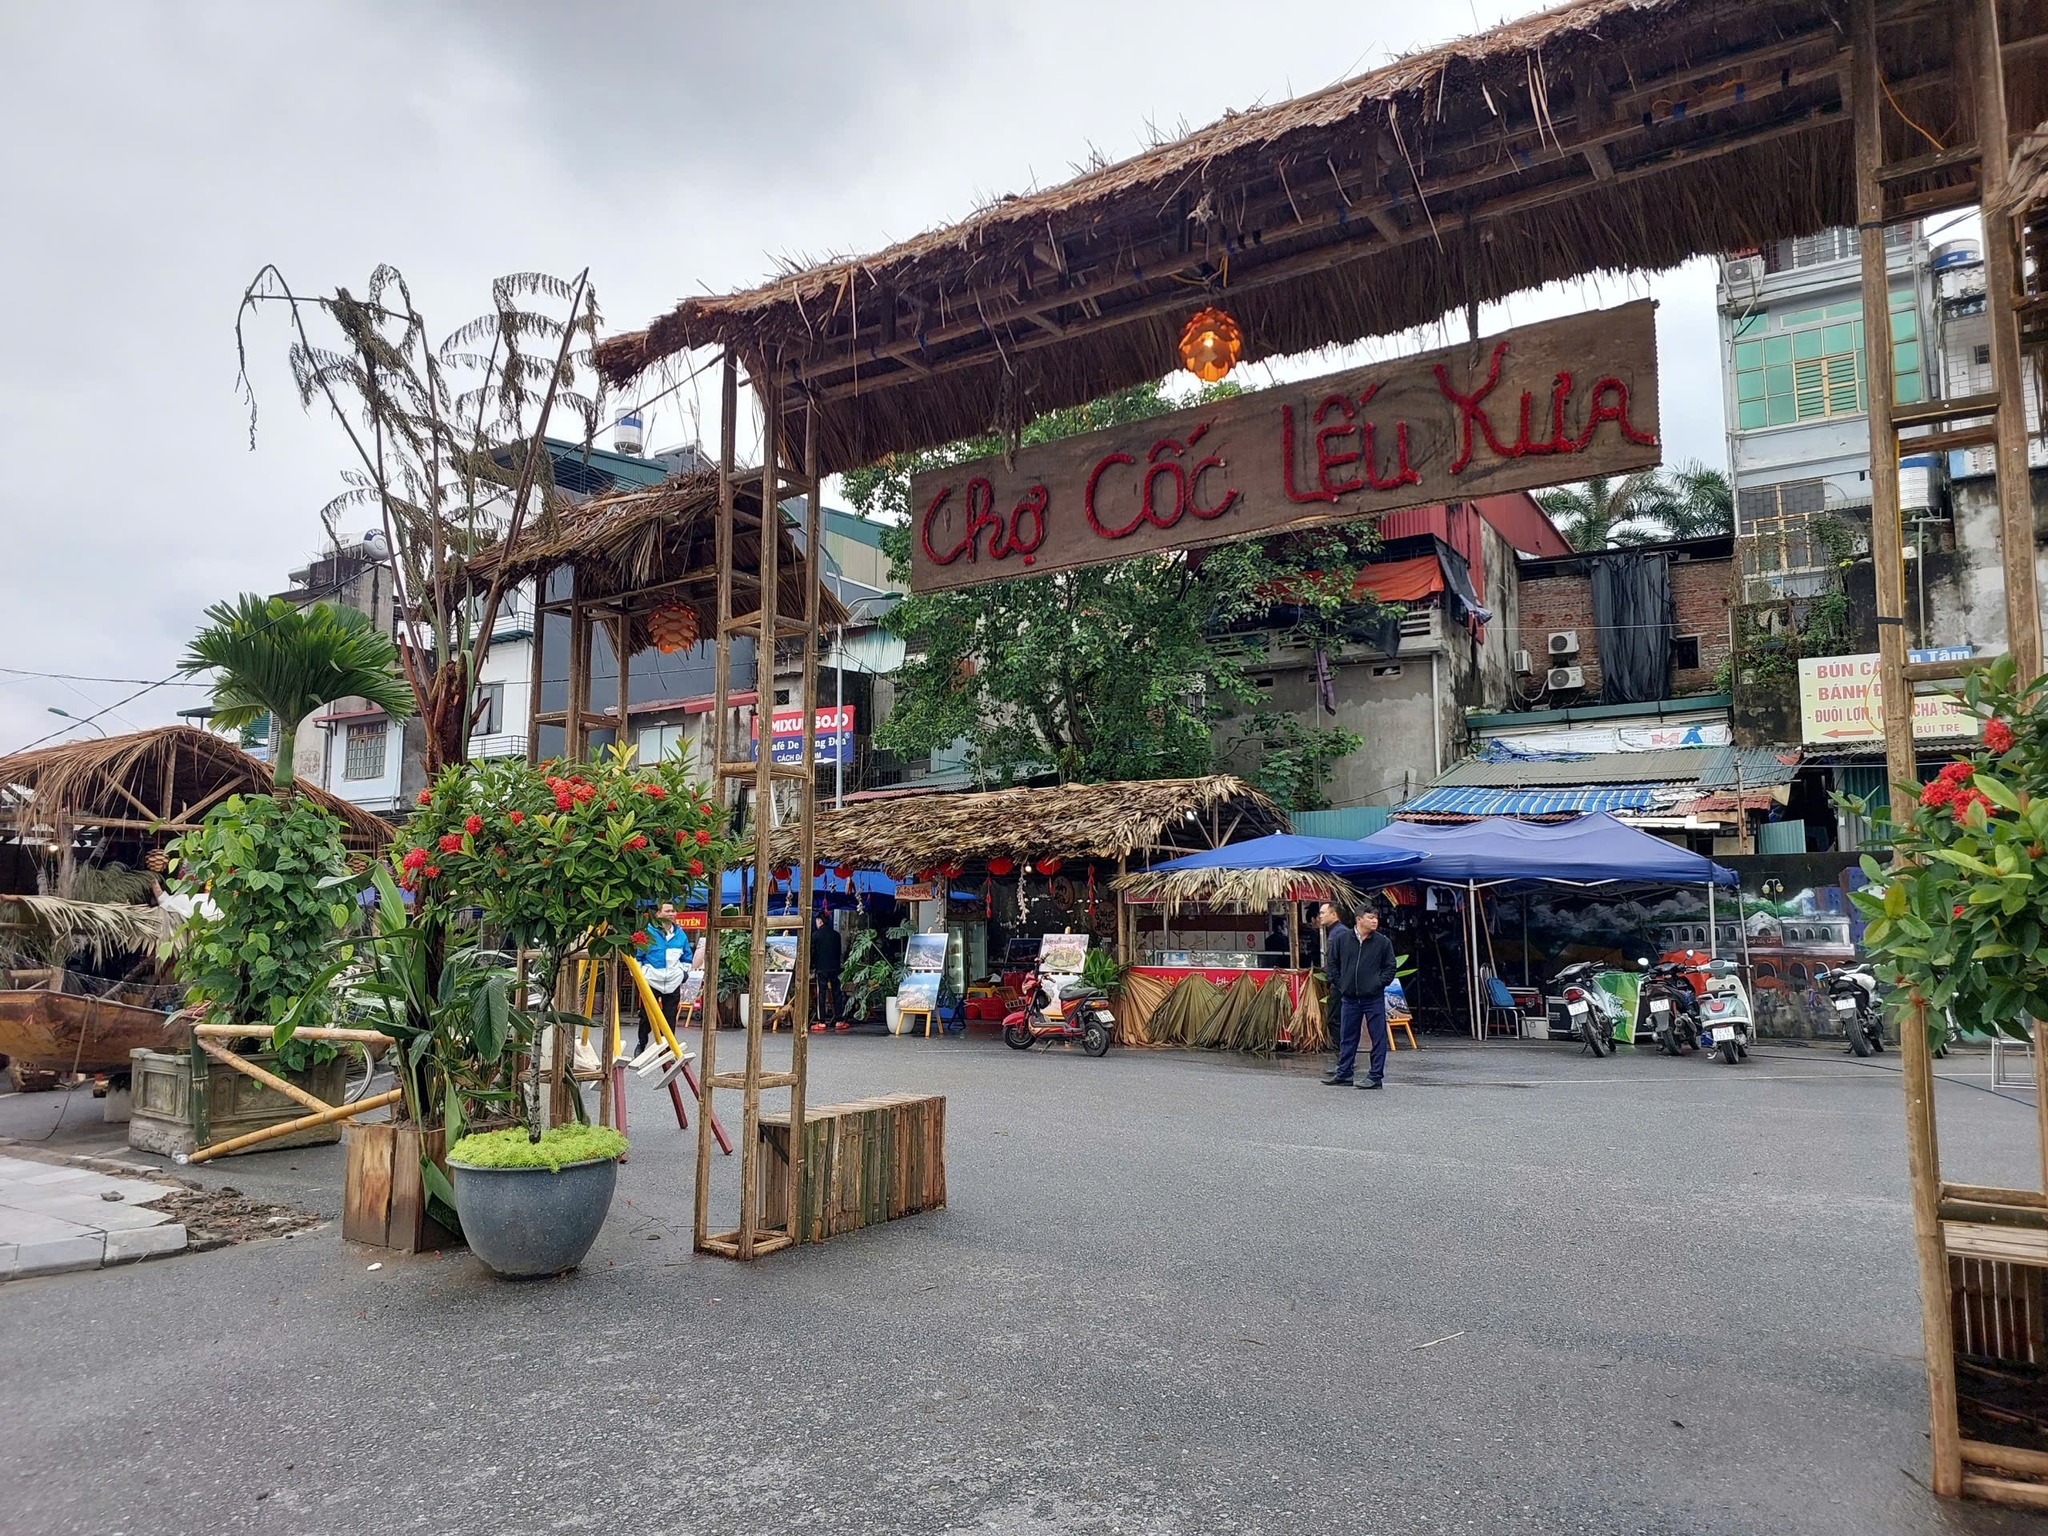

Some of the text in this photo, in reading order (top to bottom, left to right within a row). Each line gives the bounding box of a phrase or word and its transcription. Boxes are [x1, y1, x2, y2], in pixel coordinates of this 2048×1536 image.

[921, 476, 1048, 566] Chợ
[1084, 422, 1238, 540] Cốc
[1926, 649, 1970, 662] Tâm
[1817, 661, 1854, 679] BÚN
[1818, 683, 1867, 701] BÁNH
[1815, 705, 1842, 723] ĐUÔI
[1916, 722, 1960, 734] BÚI TRE
[787, 740, 799, 750] De
[777, 753, 795, 762] CÁCH
